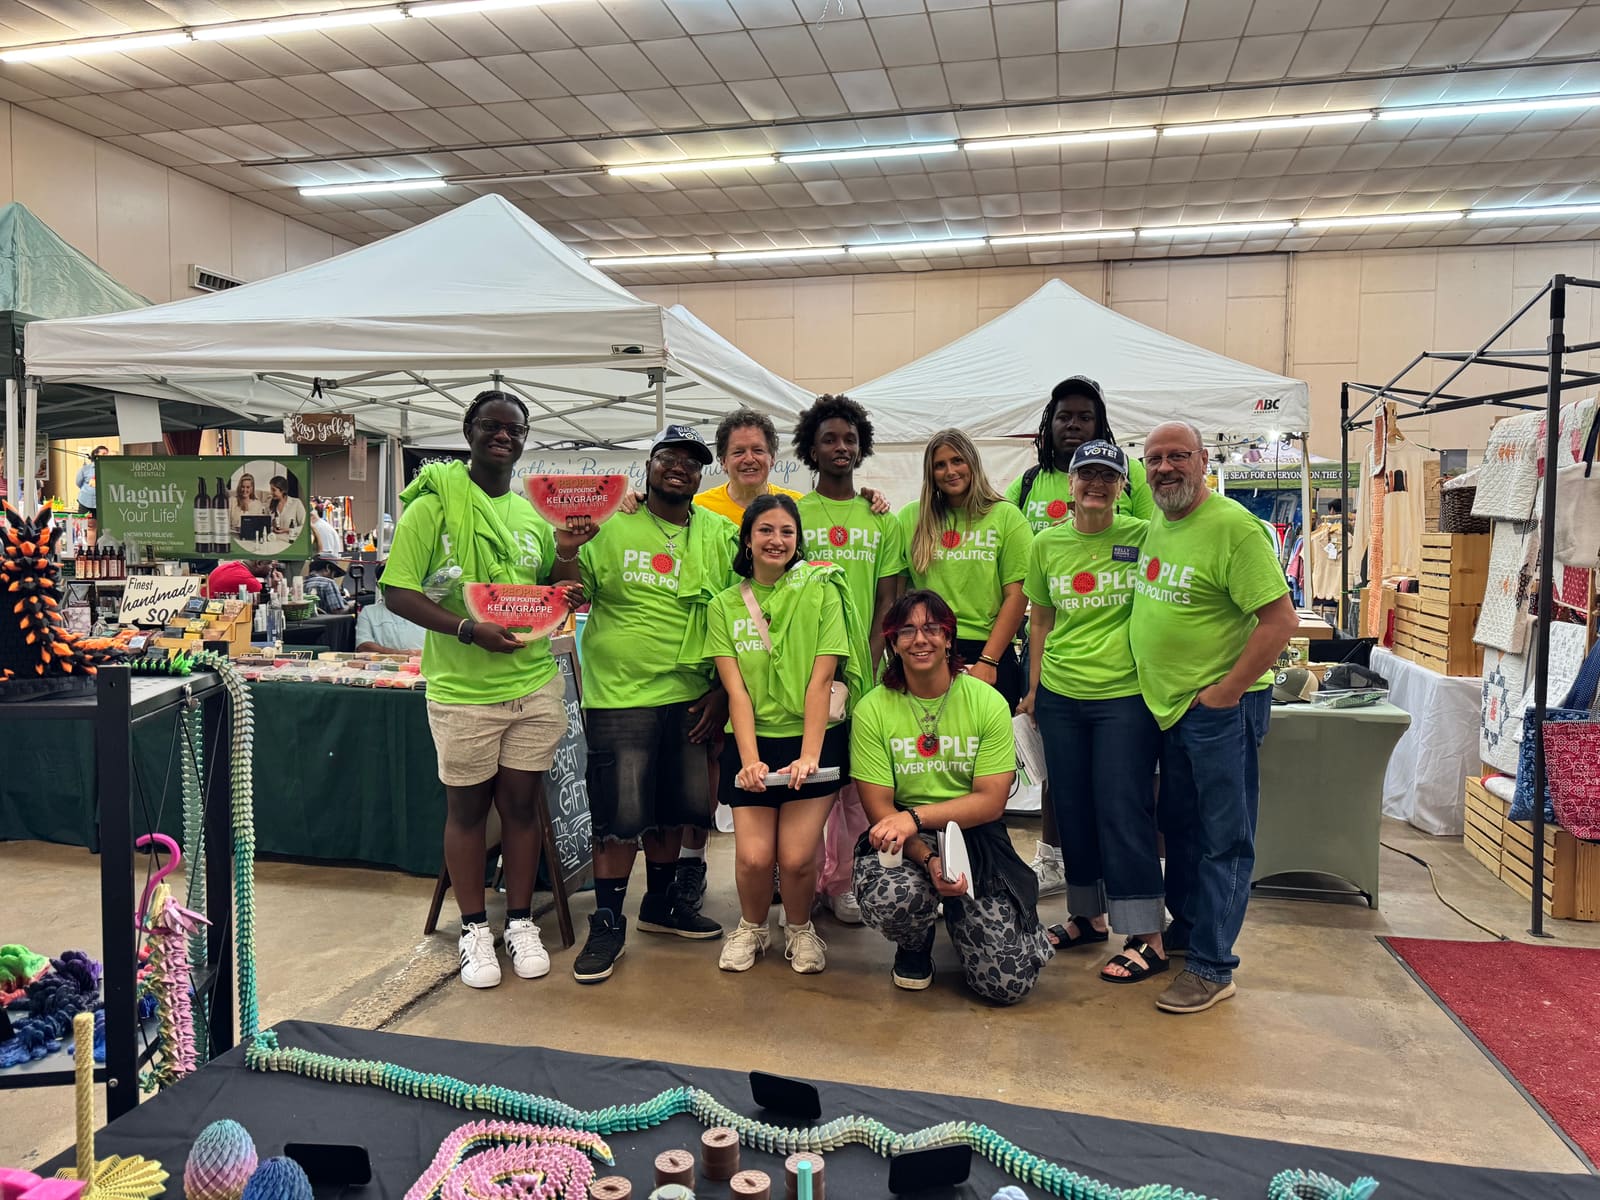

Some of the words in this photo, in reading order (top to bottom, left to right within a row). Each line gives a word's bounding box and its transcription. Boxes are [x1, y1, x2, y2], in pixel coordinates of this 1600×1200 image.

[1255, 399, 1280, 410] ABC
[1084, 447, 1118, 459] VOTE!
[559, 479, 596, 487] PEOPLE
[1230, 472, 1251, 480] SEAT
[1267, 471, 1302, 479] EVERYON
[108, 482, 188, 509] Magnify
[119, 508, 148, 522] Your
[152, 508, 178, 523] Life!
[1031, 521, 1050, 530] VER
[803, 525, 882, 549] PEOPLE
[623, 549, 682, 577] PEO
[808, 549, 834, 561] OVER
[946, 550, 996, 561] POLITICS
[128, 577, 154, 591] Finest
[623, 571, 656, 585] OVER
[1048, 568, 1138, 597] PEOPLE
[122, 579, 197, 613] handmade
[500, 586, 542, 596] PEOPLE
[1145, 583, 1191, 604] POLITICS
[1058, 598, 1081, 610] VER
[1082, 593, 1132, 609] POLITIC
[145, 608, 179, 623] SOA
[733, 618, 760, 640] PE
[889, 733, 979, 759] PEOPLE
[549, 743, 578, 781] GREAT
[895, 762, 925, 775] OVER
[927, 760, 973, 773] POLITIC
[559, 781, 589, 815] GIFT
[552, 816, 568, 835] The
[555, 832, 580, 863] BEST
